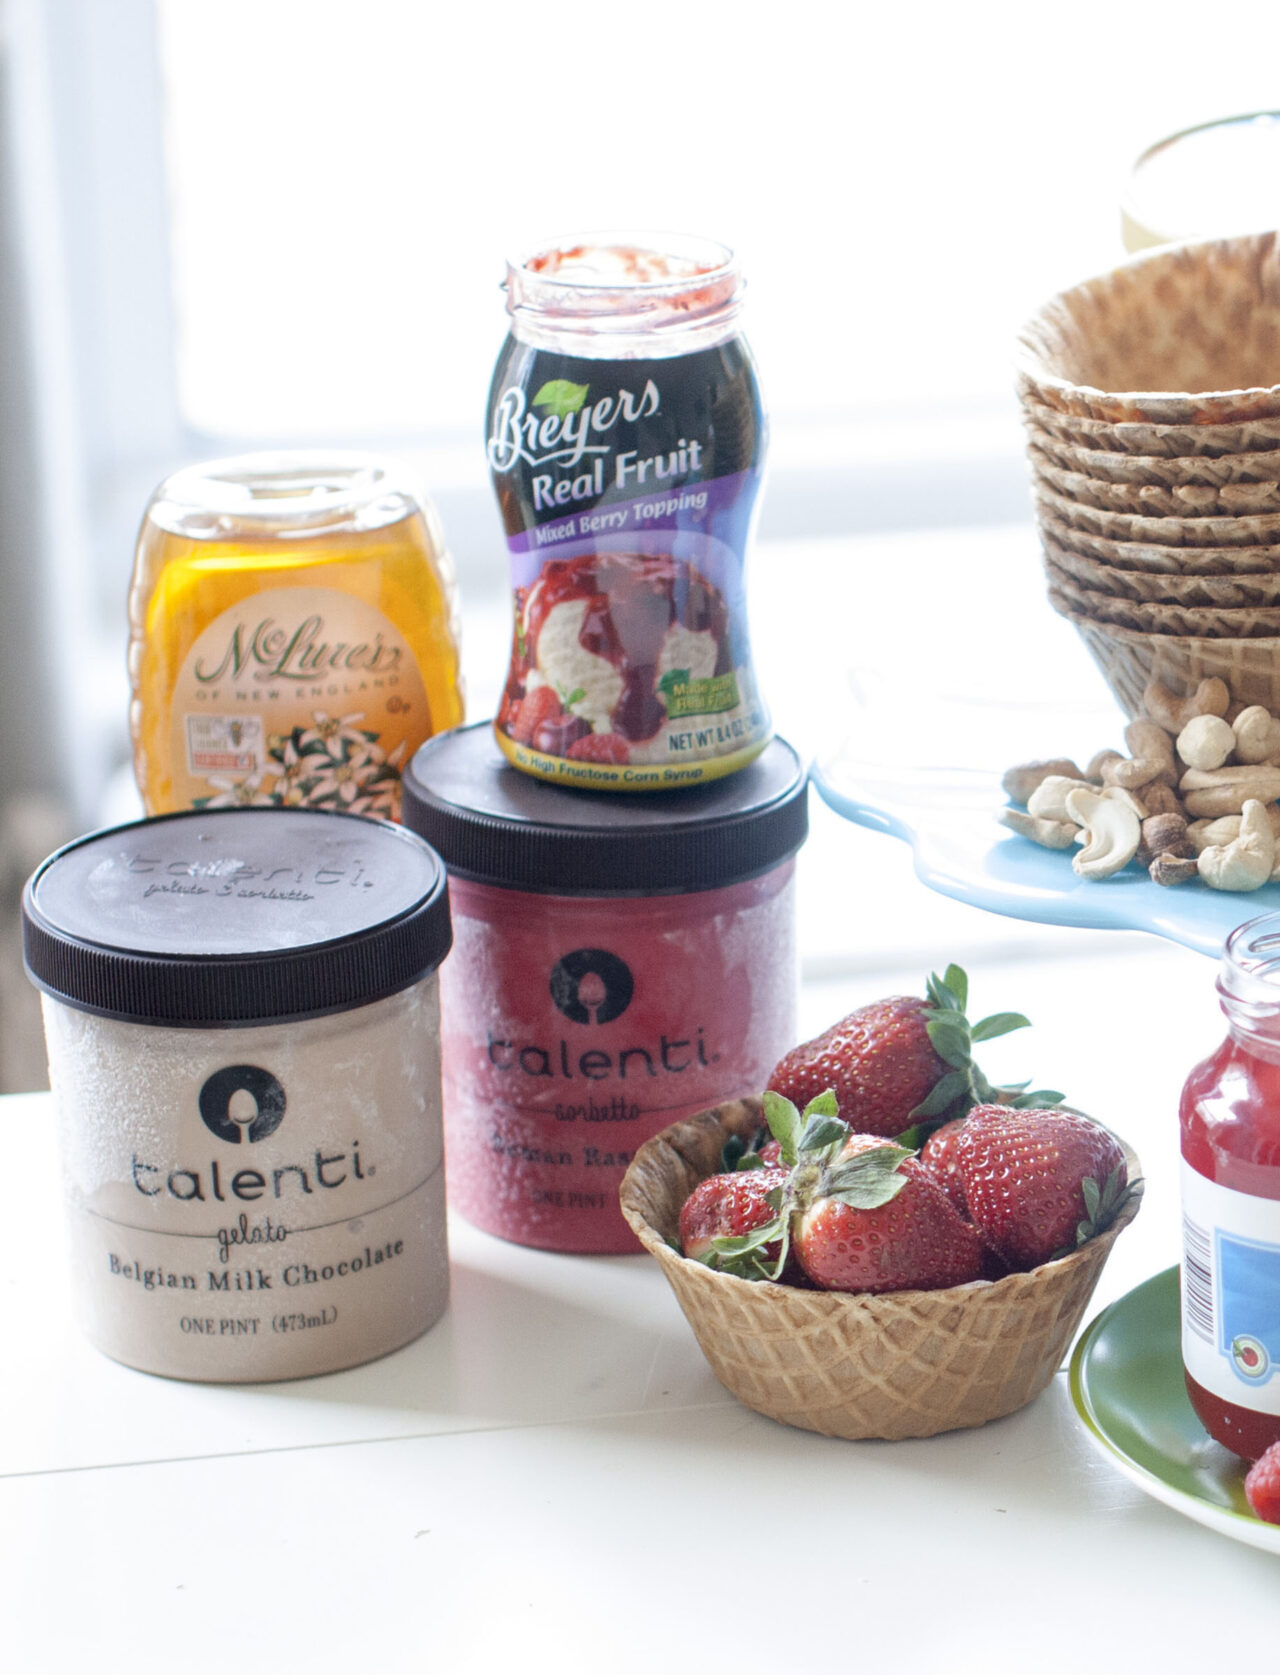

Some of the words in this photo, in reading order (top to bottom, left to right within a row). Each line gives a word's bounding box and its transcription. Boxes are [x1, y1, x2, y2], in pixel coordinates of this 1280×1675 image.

[488, 379, 660, 472] Breyers
[532, 458, 604, 511] Real
[615, 438, 703, 489] Fruit
[535, 520, 576, 545] Mixed
[579, 509, 628, 533] Berry
[633, 491, 708, 521] Topping
[195, 690, 220, 701] OF
[236, 689, 280, 701] NEW
[295, 675, 401, 699] ENGLAND
[669, 733, 692, 751] NET
[696, 729, 714, 749] WT
[516, 752, 529, 765] No
[530, 755, 555, 774] High
[559, 763, 619, 782] Fructose
[623, 770, 659, 783] Corn
[663, 767, 704, 782] Syrup
[129, 854, 365, 887] taenti
[554, 1096, 640, 1122] sorbetto
[531, 1190, 563, 1208] ONE
[567, 1192, 607, 1209] PINT
[217, 1213, 289, 1264] gelato
[109, 1253, 197, 1291] Belgian
[208, 1269, 273, 1292] Milk
[283, 1236, 405, 1288] Chocolate
[180, 1316, 216, 1334] ONE
[220, 1318, 261, 1335] PINT
[272, 1305, 338, 1335] (473mL)
